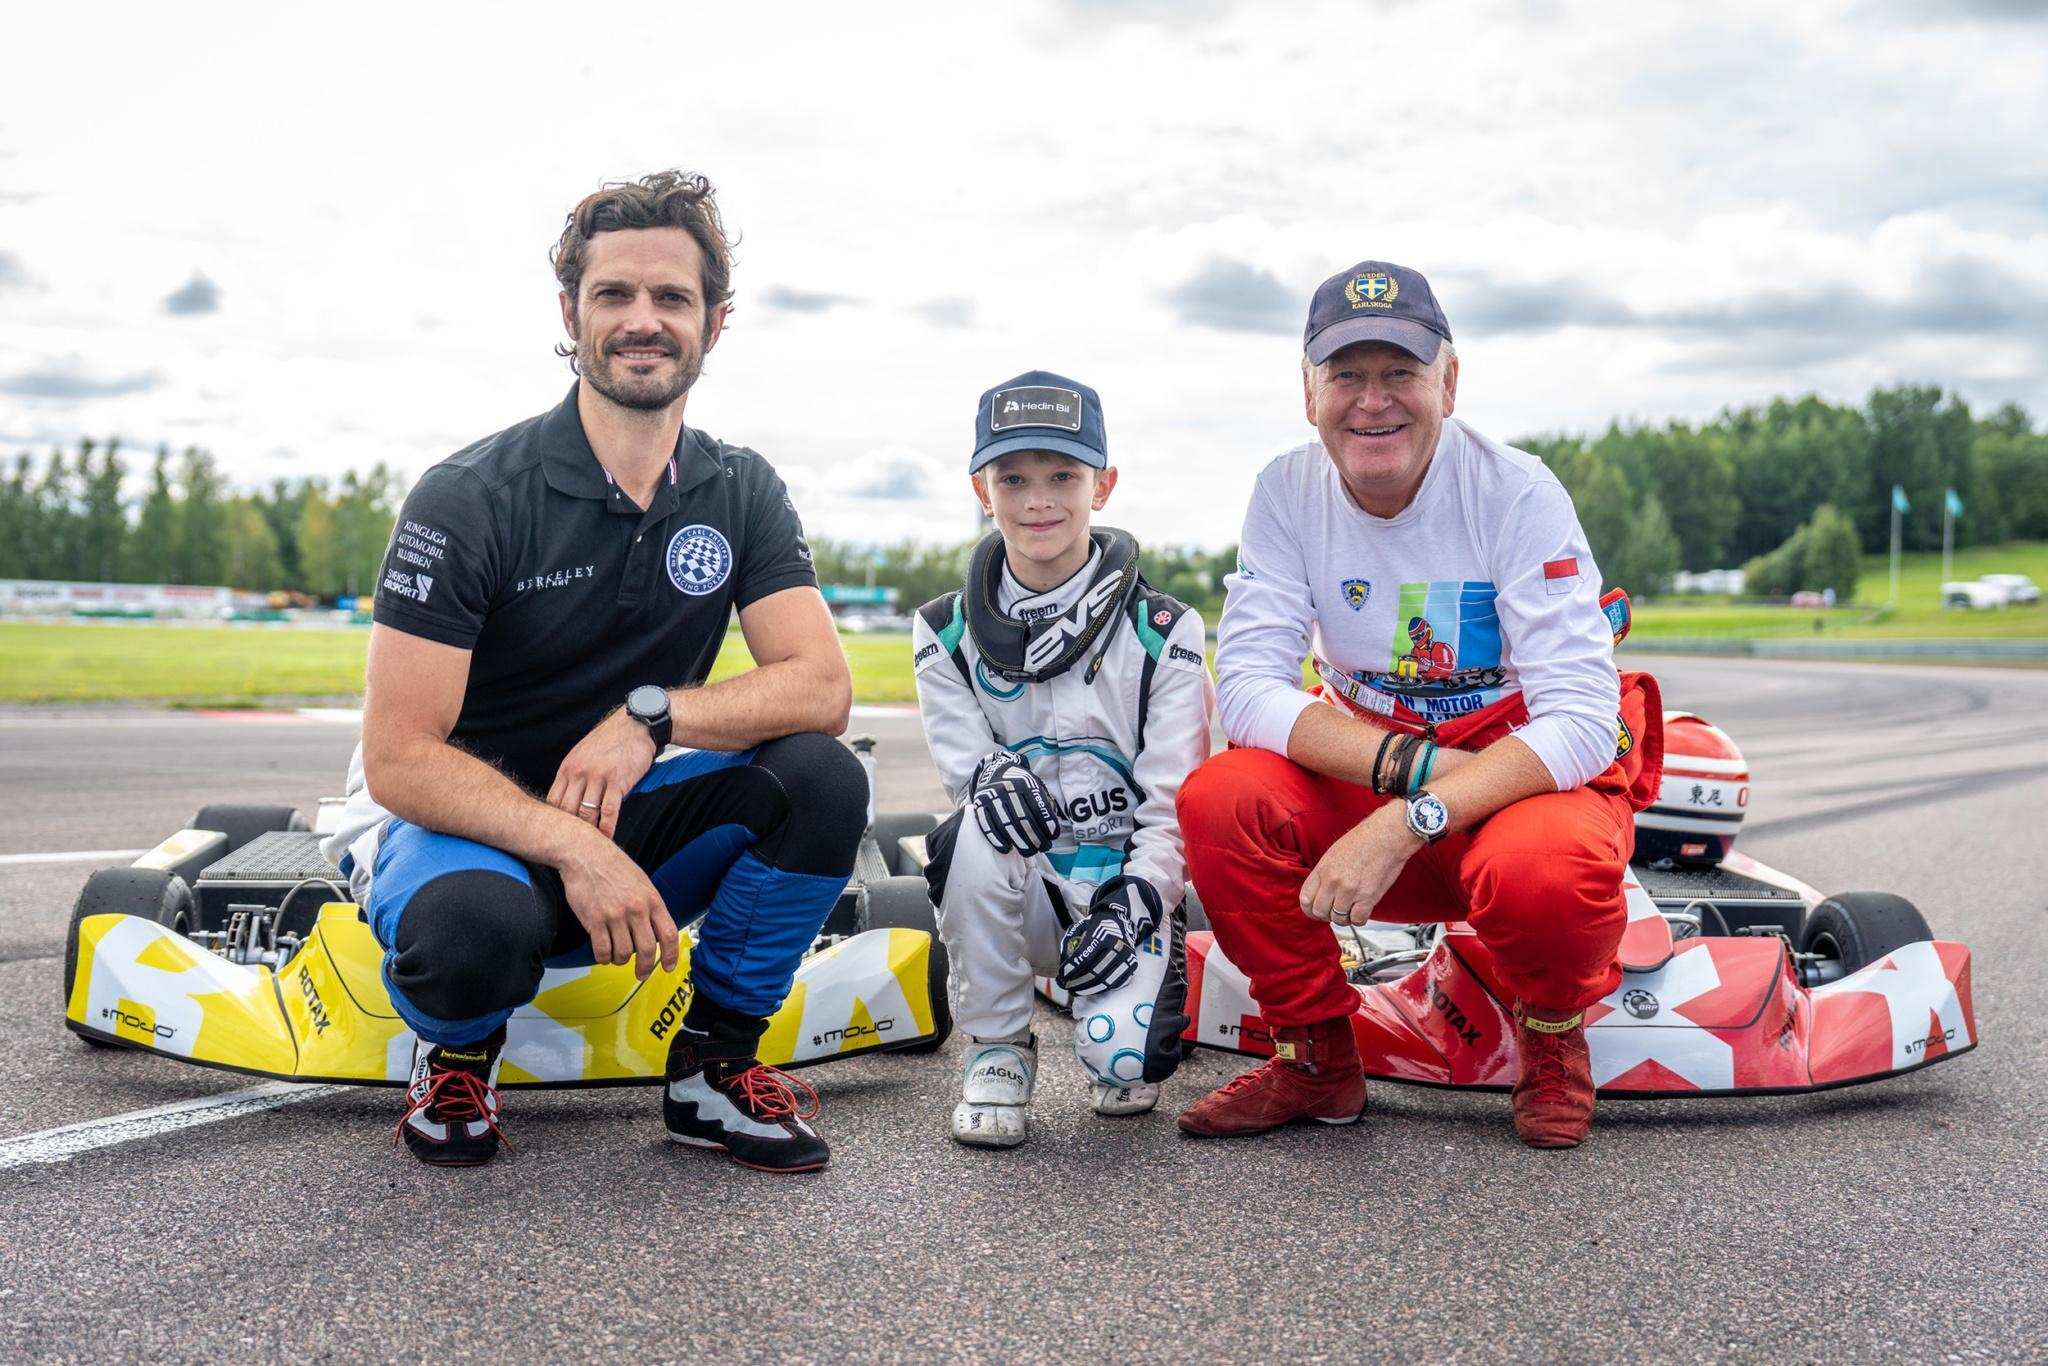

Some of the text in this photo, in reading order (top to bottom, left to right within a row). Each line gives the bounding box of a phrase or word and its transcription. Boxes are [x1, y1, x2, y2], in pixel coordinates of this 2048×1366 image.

[1352, 301, 1393, 309] KARLSKOGA
[1021, 401, 1070, 413] Hedin Bil
[403, 520, 448, 546] KUNGLIGA
[396, 547, 432, 569] KLUBBEN
[516, 565, 594, 592] BERKELEY
[1018, 602, 1058, 621] freem
[1023, 569, 1124, 672] EVS
[1168, 643, 1203, 666] freem
[1425, 693, 1484, 713] MOTOR
[1031, 784, 1050, 819] freem
[1073, 937, 1100, 965] freem
[299, 964, 332, 1036] ROTAX
[1639, 1003, 1658, 1011] BRP
[971, 1066, 1024, 1086] FRAGUS
